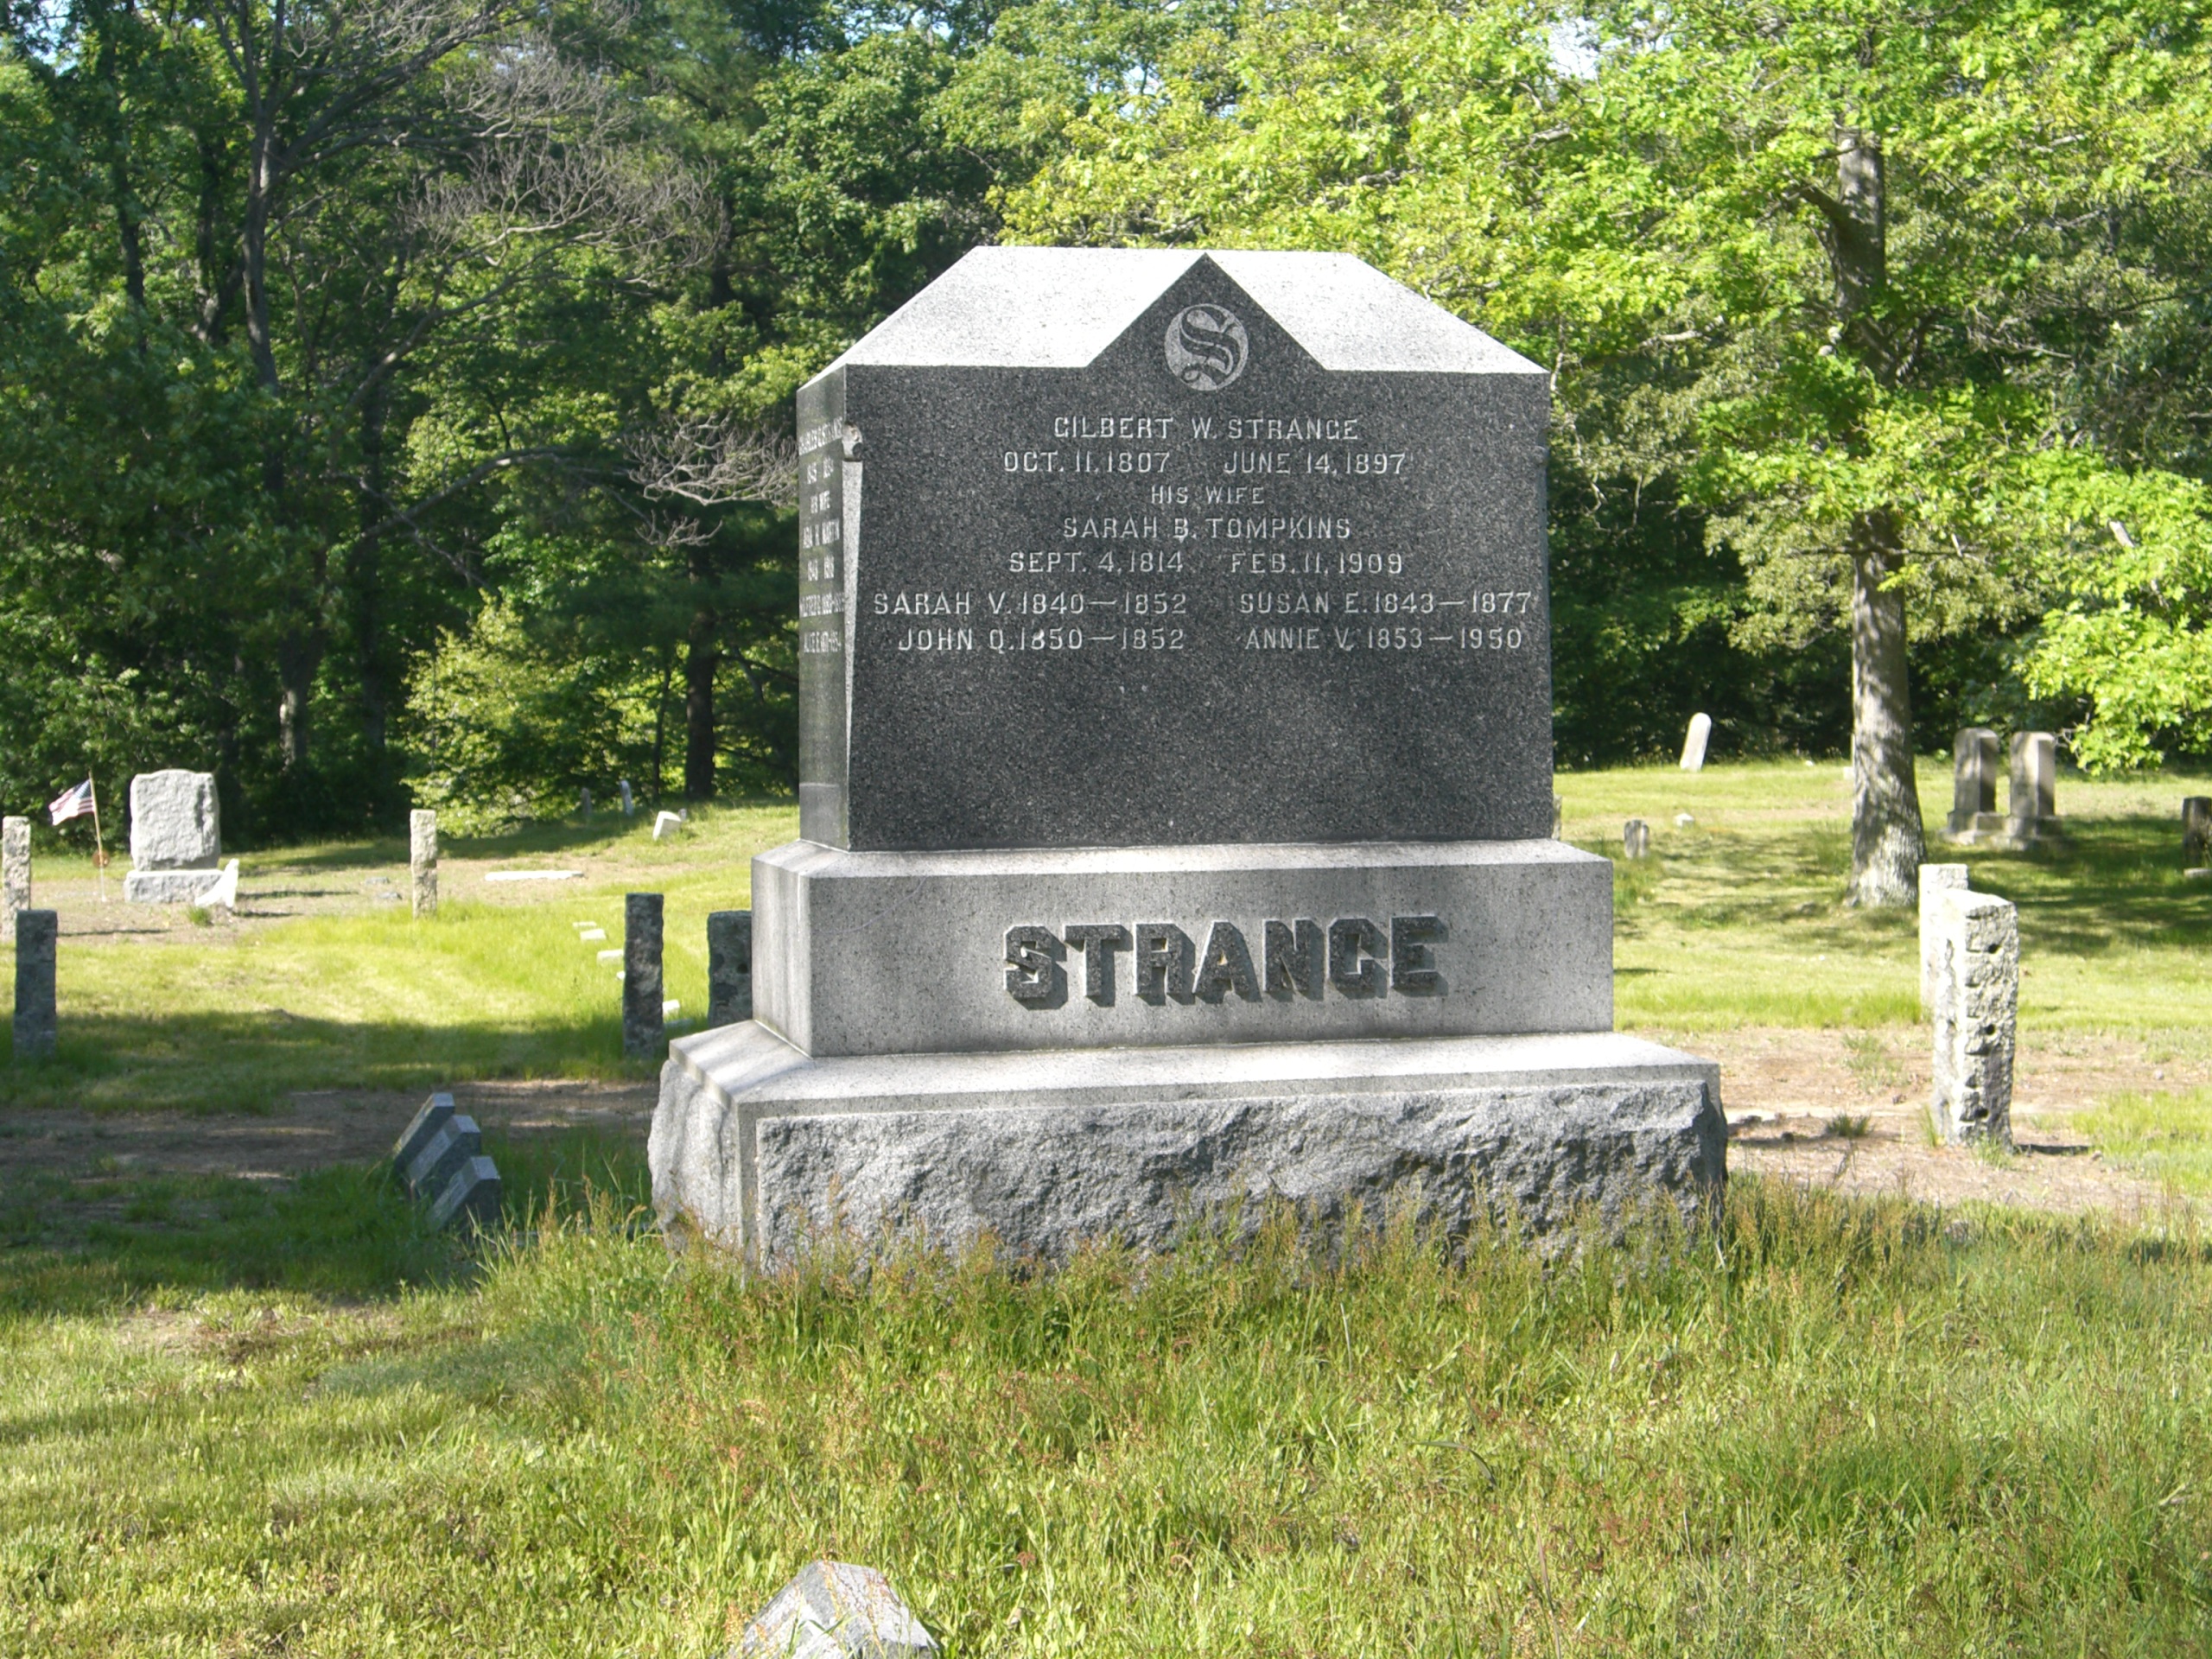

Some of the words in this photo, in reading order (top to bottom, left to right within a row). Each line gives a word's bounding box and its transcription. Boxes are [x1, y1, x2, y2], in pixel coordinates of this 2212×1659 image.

[1054, 416, 1173, 439] GILBERT
[1228, 418, 1358, 440] STRANGE
[1004, 451, 1064, 473] OCT.
[1224, 453, 1291, 474] JUNE
[1152, 486, 1189, 505] HIS
[1205, 487, 1265, 505] WIFE
[1064, 517, 1158, 538] SARAH
[1205, 518, 1351, 539] TOMPKINS
[1009, 552, 1087, 573] SEPT.
[1231, 553, 1295, 574] FEB.
[874, 592, 970, 615] SARAH
[1240, 593, 1330, 614] SUSAN
[899, 628, 973, 651] JOHN
[1244, 628, 1320, 650] ANNIE
[1003, 915, 1449, 1010] STRANGE
